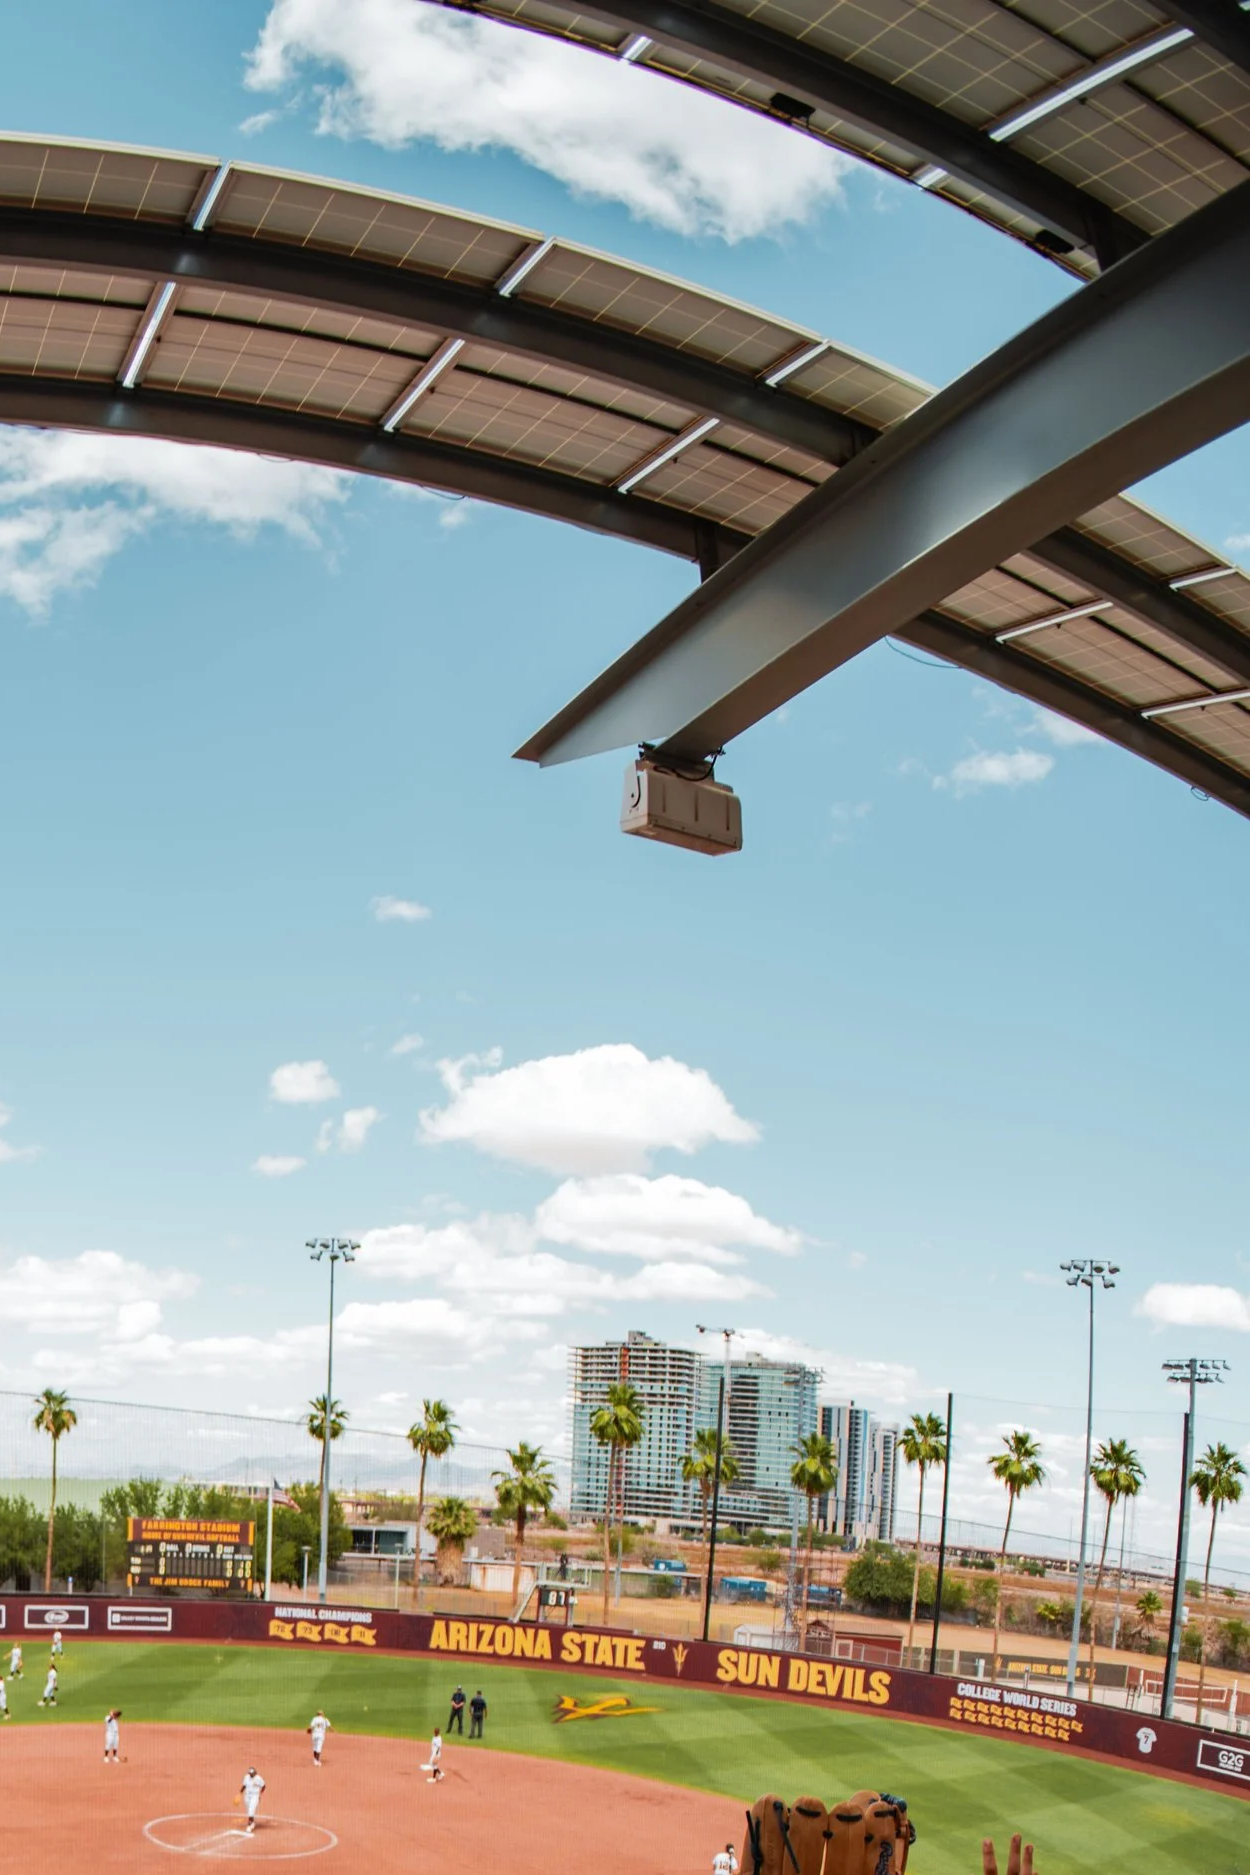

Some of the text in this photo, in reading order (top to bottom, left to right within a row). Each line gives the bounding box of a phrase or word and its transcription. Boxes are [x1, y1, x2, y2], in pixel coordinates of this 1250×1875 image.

[274, 1606, 373, 1624] NATIONAL CHAMPIONS
[429, 1619, 646, 1671] ARIZONA STATE
[716, 1649, 892, 1705] SUN DEVILS
[957, 1682, 1078, 1717] COLLEGE WORLD SERIES
[1218, 1750, 1245, 1768] G2G
